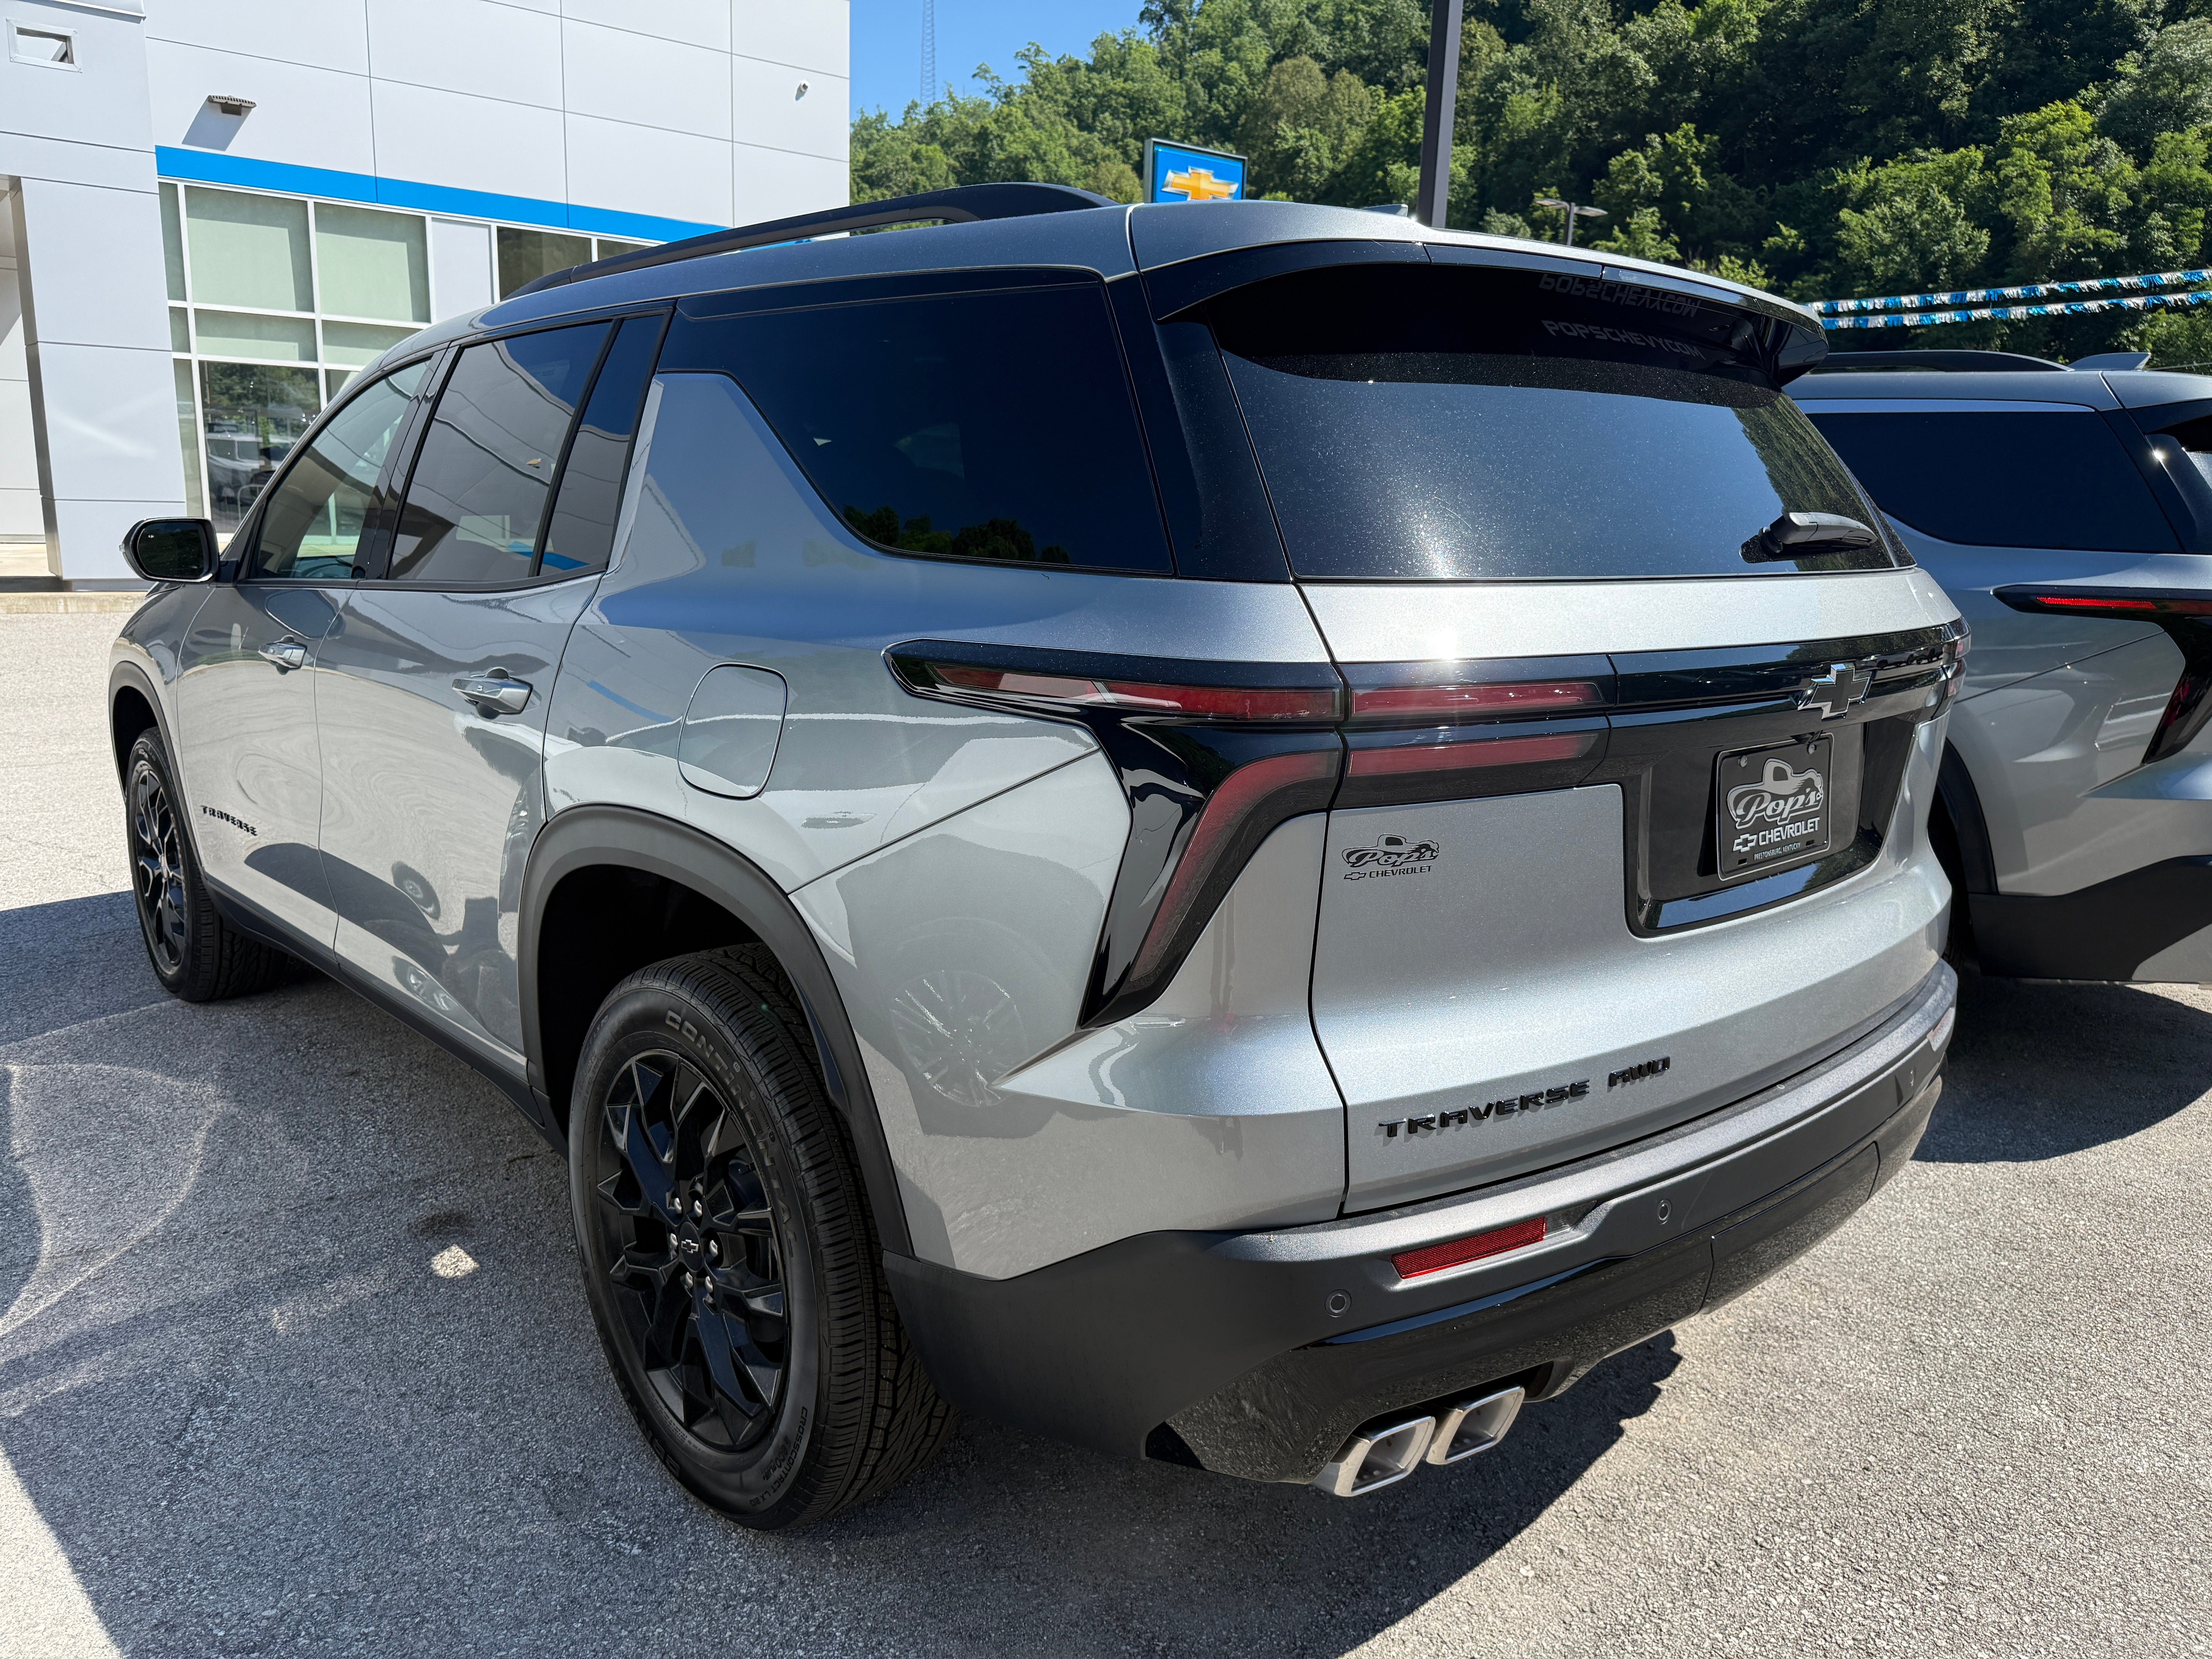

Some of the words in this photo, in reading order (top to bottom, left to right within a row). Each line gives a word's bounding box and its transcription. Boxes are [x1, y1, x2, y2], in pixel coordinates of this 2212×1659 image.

[1736, 788, 1819, 822] Pop's
[200, 805, 258, 836] TRAVERSE
[1759, 817, 1820, 846] CHEVROLET
[1348, 848, 1436, 868] Pop's
[1783, 842, 1800, 852] KENTUCKY
[1369, 865, 1433, 878] CHEVROLET
[1378, 1078, 1590, 1138] TRAVERSE
[1608, 1055, 1671, 1087] AWD
[665, 1009, 797, 1257] CONTINENTAL
